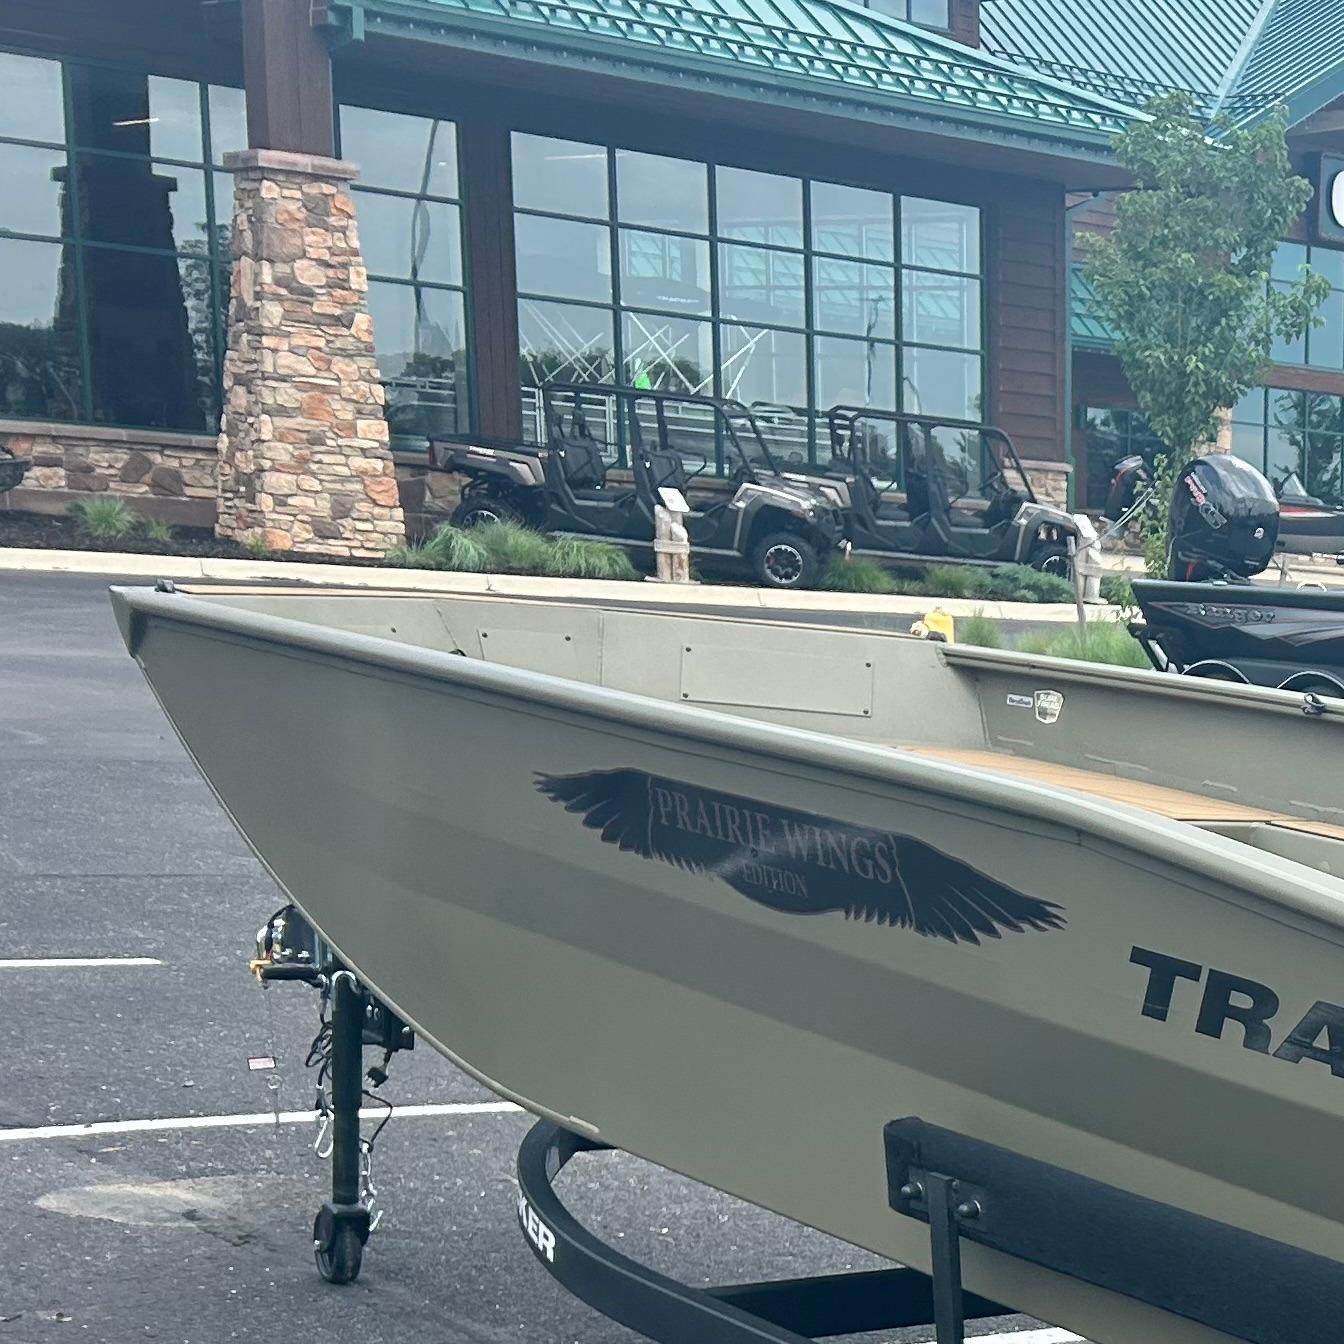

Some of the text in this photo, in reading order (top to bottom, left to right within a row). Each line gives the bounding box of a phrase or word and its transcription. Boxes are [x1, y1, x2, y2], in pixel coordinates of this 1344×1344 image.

[655, 787, 893, 885] PRAIRIE WINGS
[741, 860, 809, 898] EDITION
